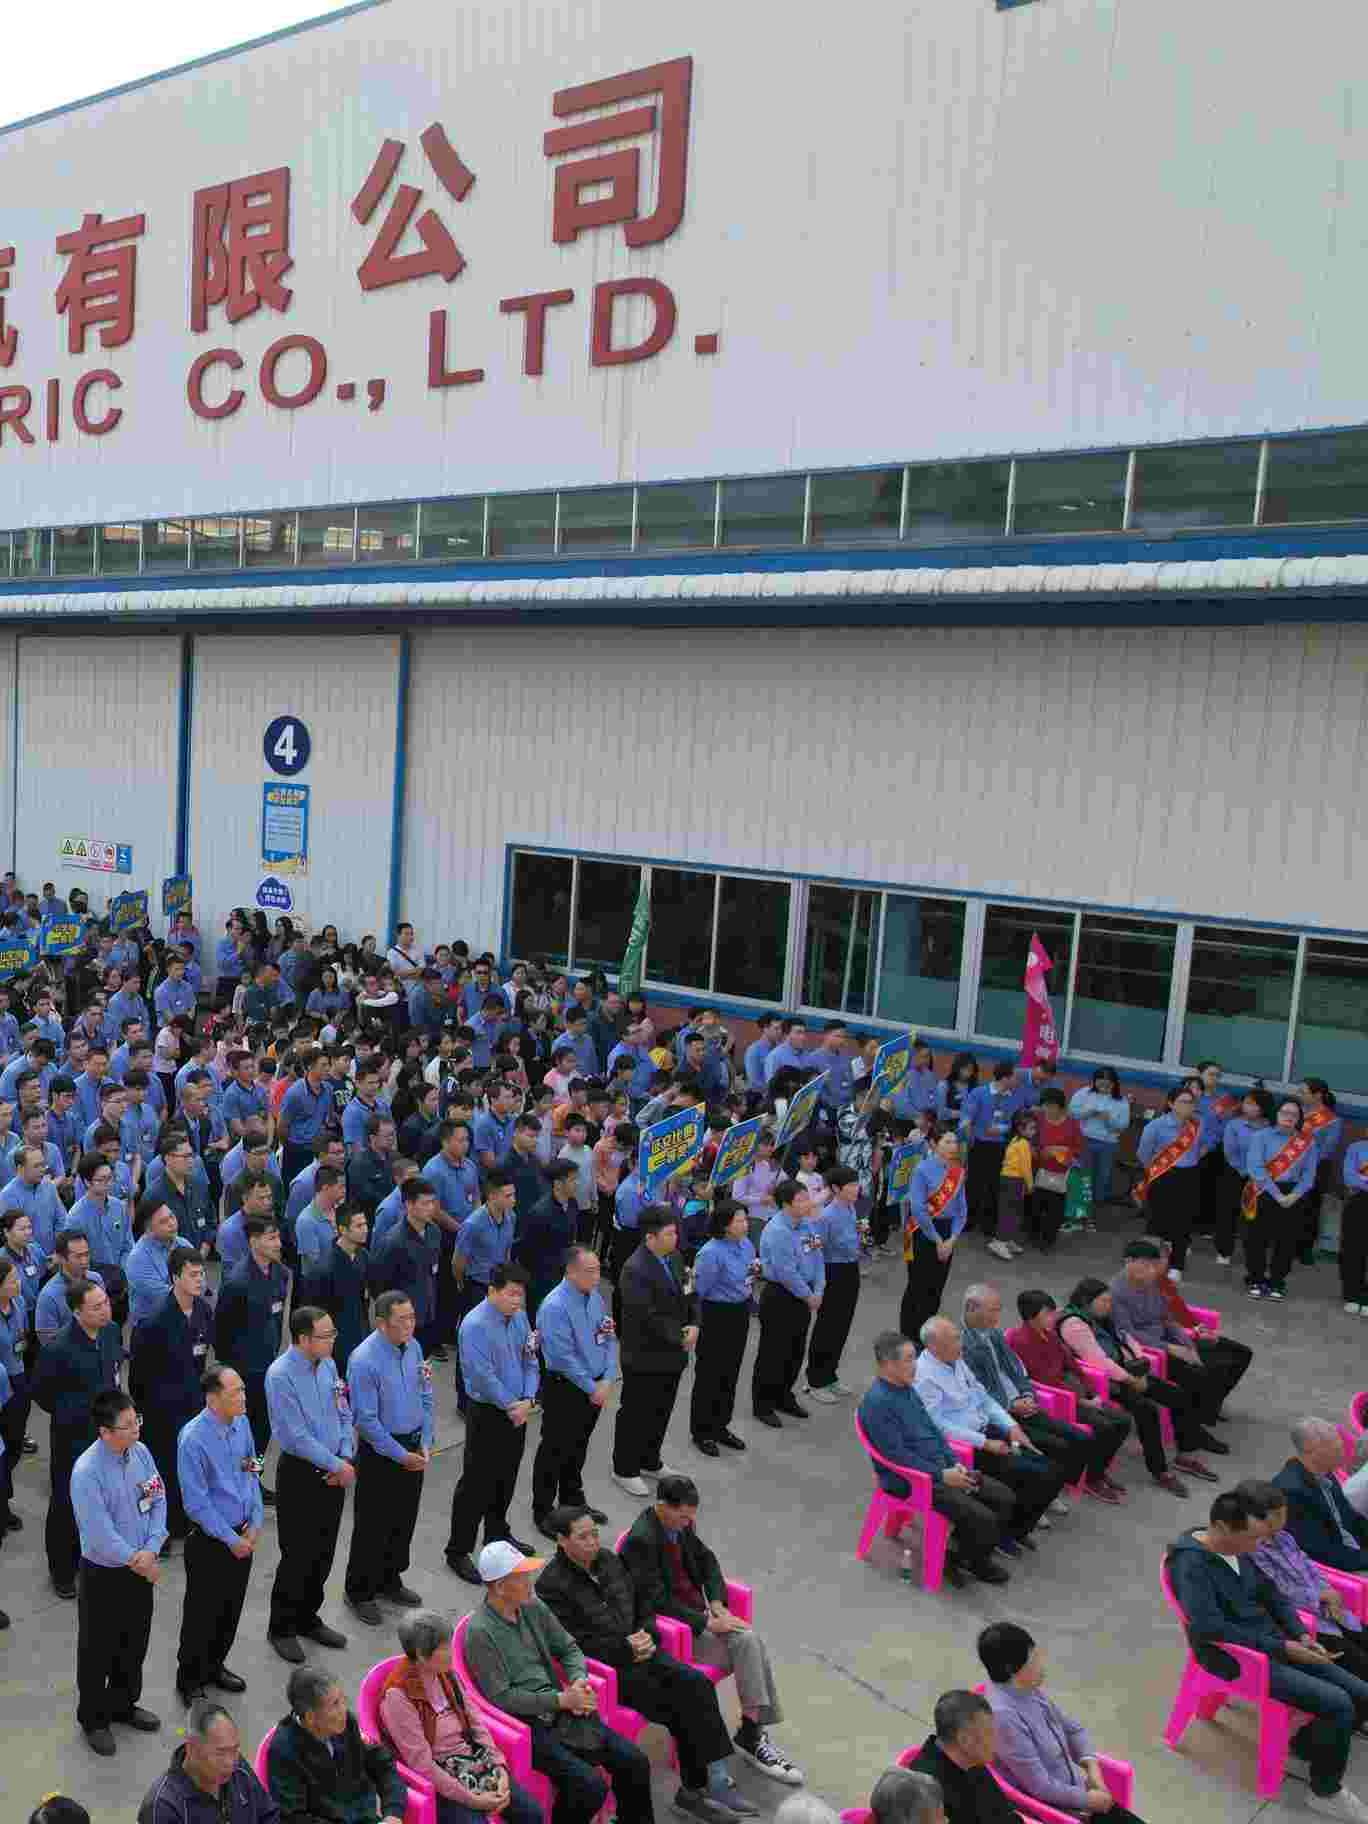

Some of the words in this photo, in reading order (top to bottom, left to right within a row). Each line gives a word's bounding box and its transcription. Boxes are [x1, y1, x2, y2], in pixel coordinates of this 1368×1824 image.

[186, 334, 387, 419] CO.,
[427, 276, 719, 390] LTD.
[273, 724, 298, 766] 4
